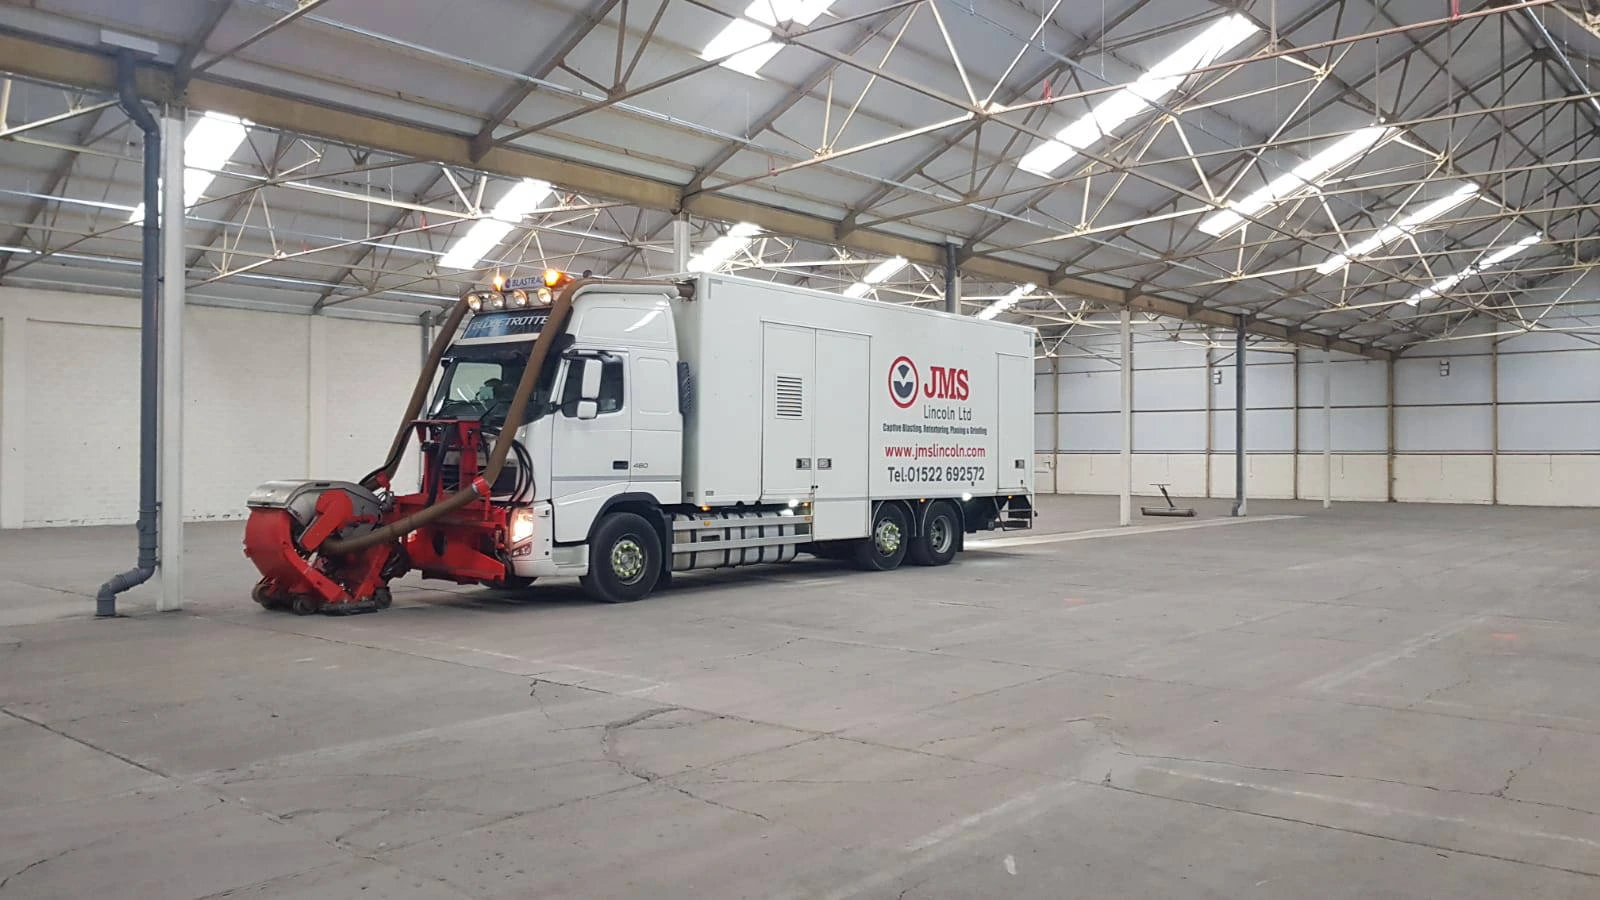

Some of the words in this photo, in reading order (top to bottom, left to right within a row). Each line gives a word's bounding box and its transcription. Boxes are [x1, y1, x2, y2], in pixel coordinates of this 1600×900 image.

[924, 366, 969, 401] JMS
[924, 404, 955, 420] Lincoln
[958, 408, 972, 421] Ltd
[883, 423, 901, 432] Captive
[884, 443, 986, 460] www.jmslincoln.com
[887, 466, 943, 482] Tel:01522
[945, 466, 985, 481] 692572
